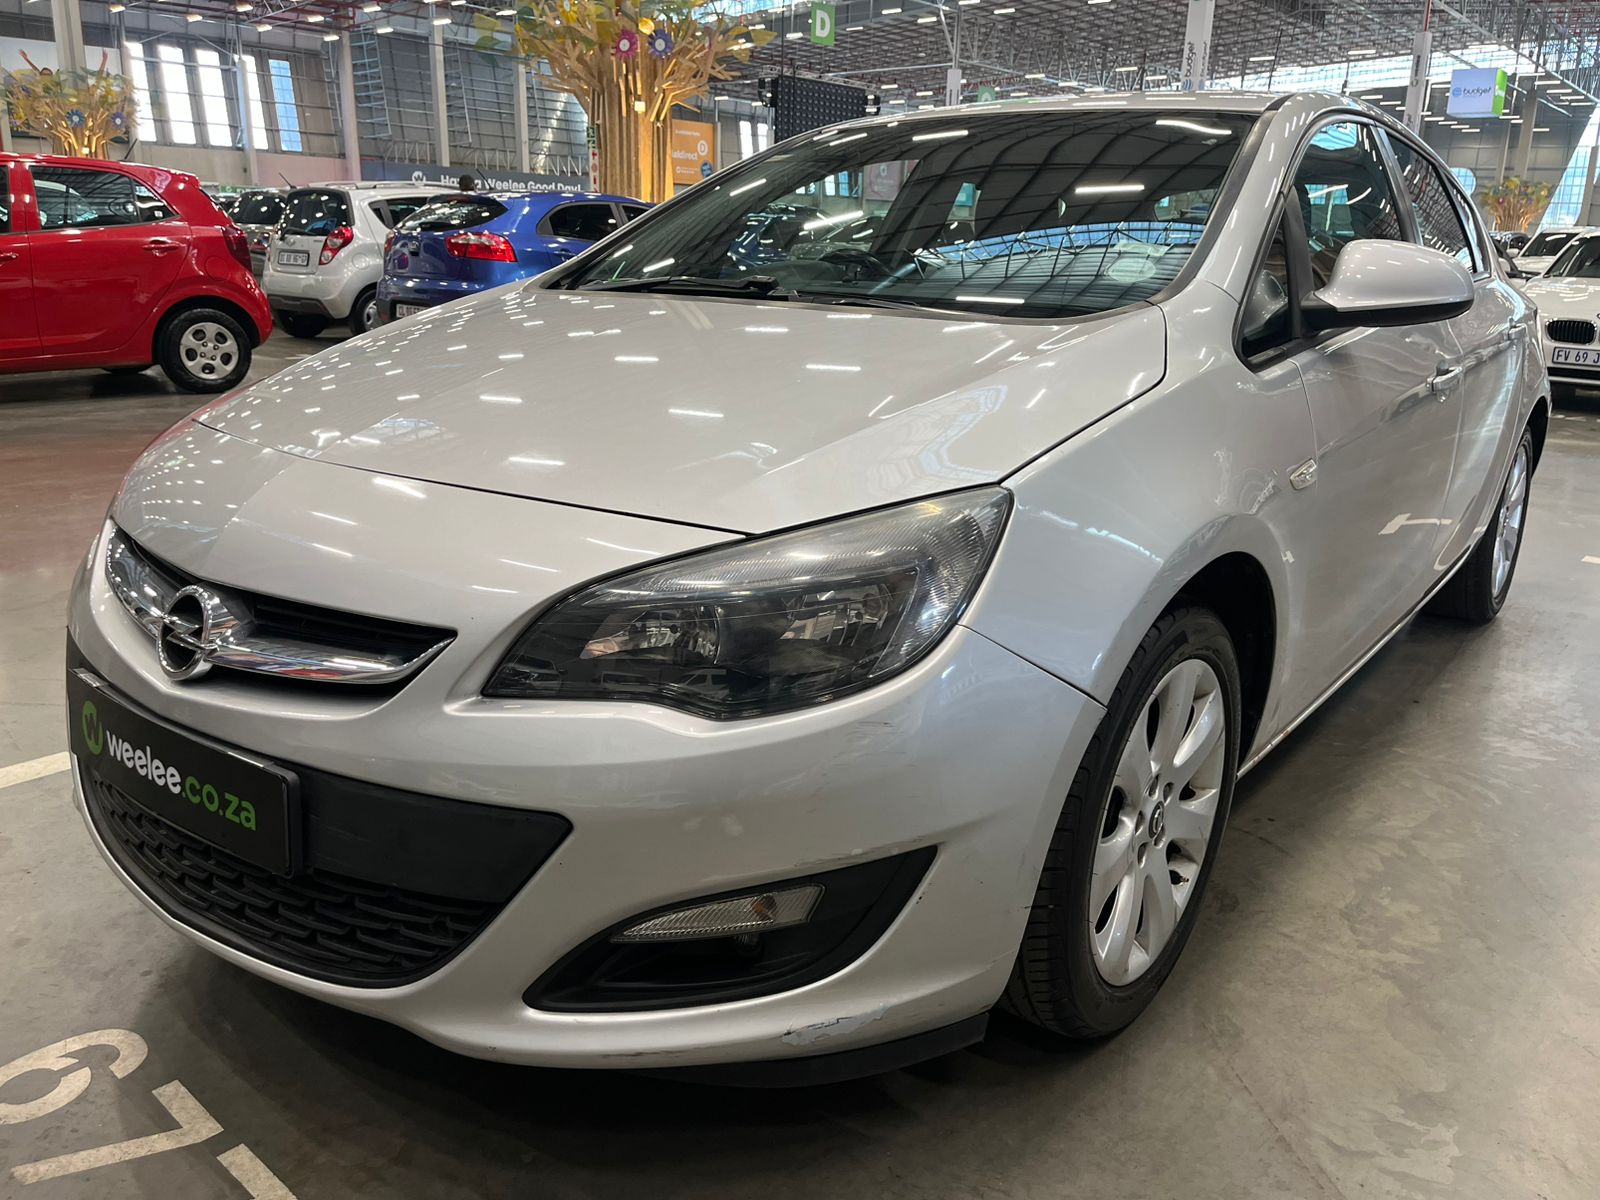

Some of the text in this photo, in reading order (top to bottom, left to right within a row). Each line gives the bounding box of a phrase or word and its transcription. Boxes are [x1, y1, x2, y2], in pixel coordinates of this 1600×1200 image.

[815, 9, 830, 38] D
[1184, 41, 1197, 78] budget
[1462, 86, 1492, 97] budget
[1556, 350, 1571, 361] FV
[1575, 352, 1588, 363] 69
[105, 729, 257, 832] weelee.co.za
